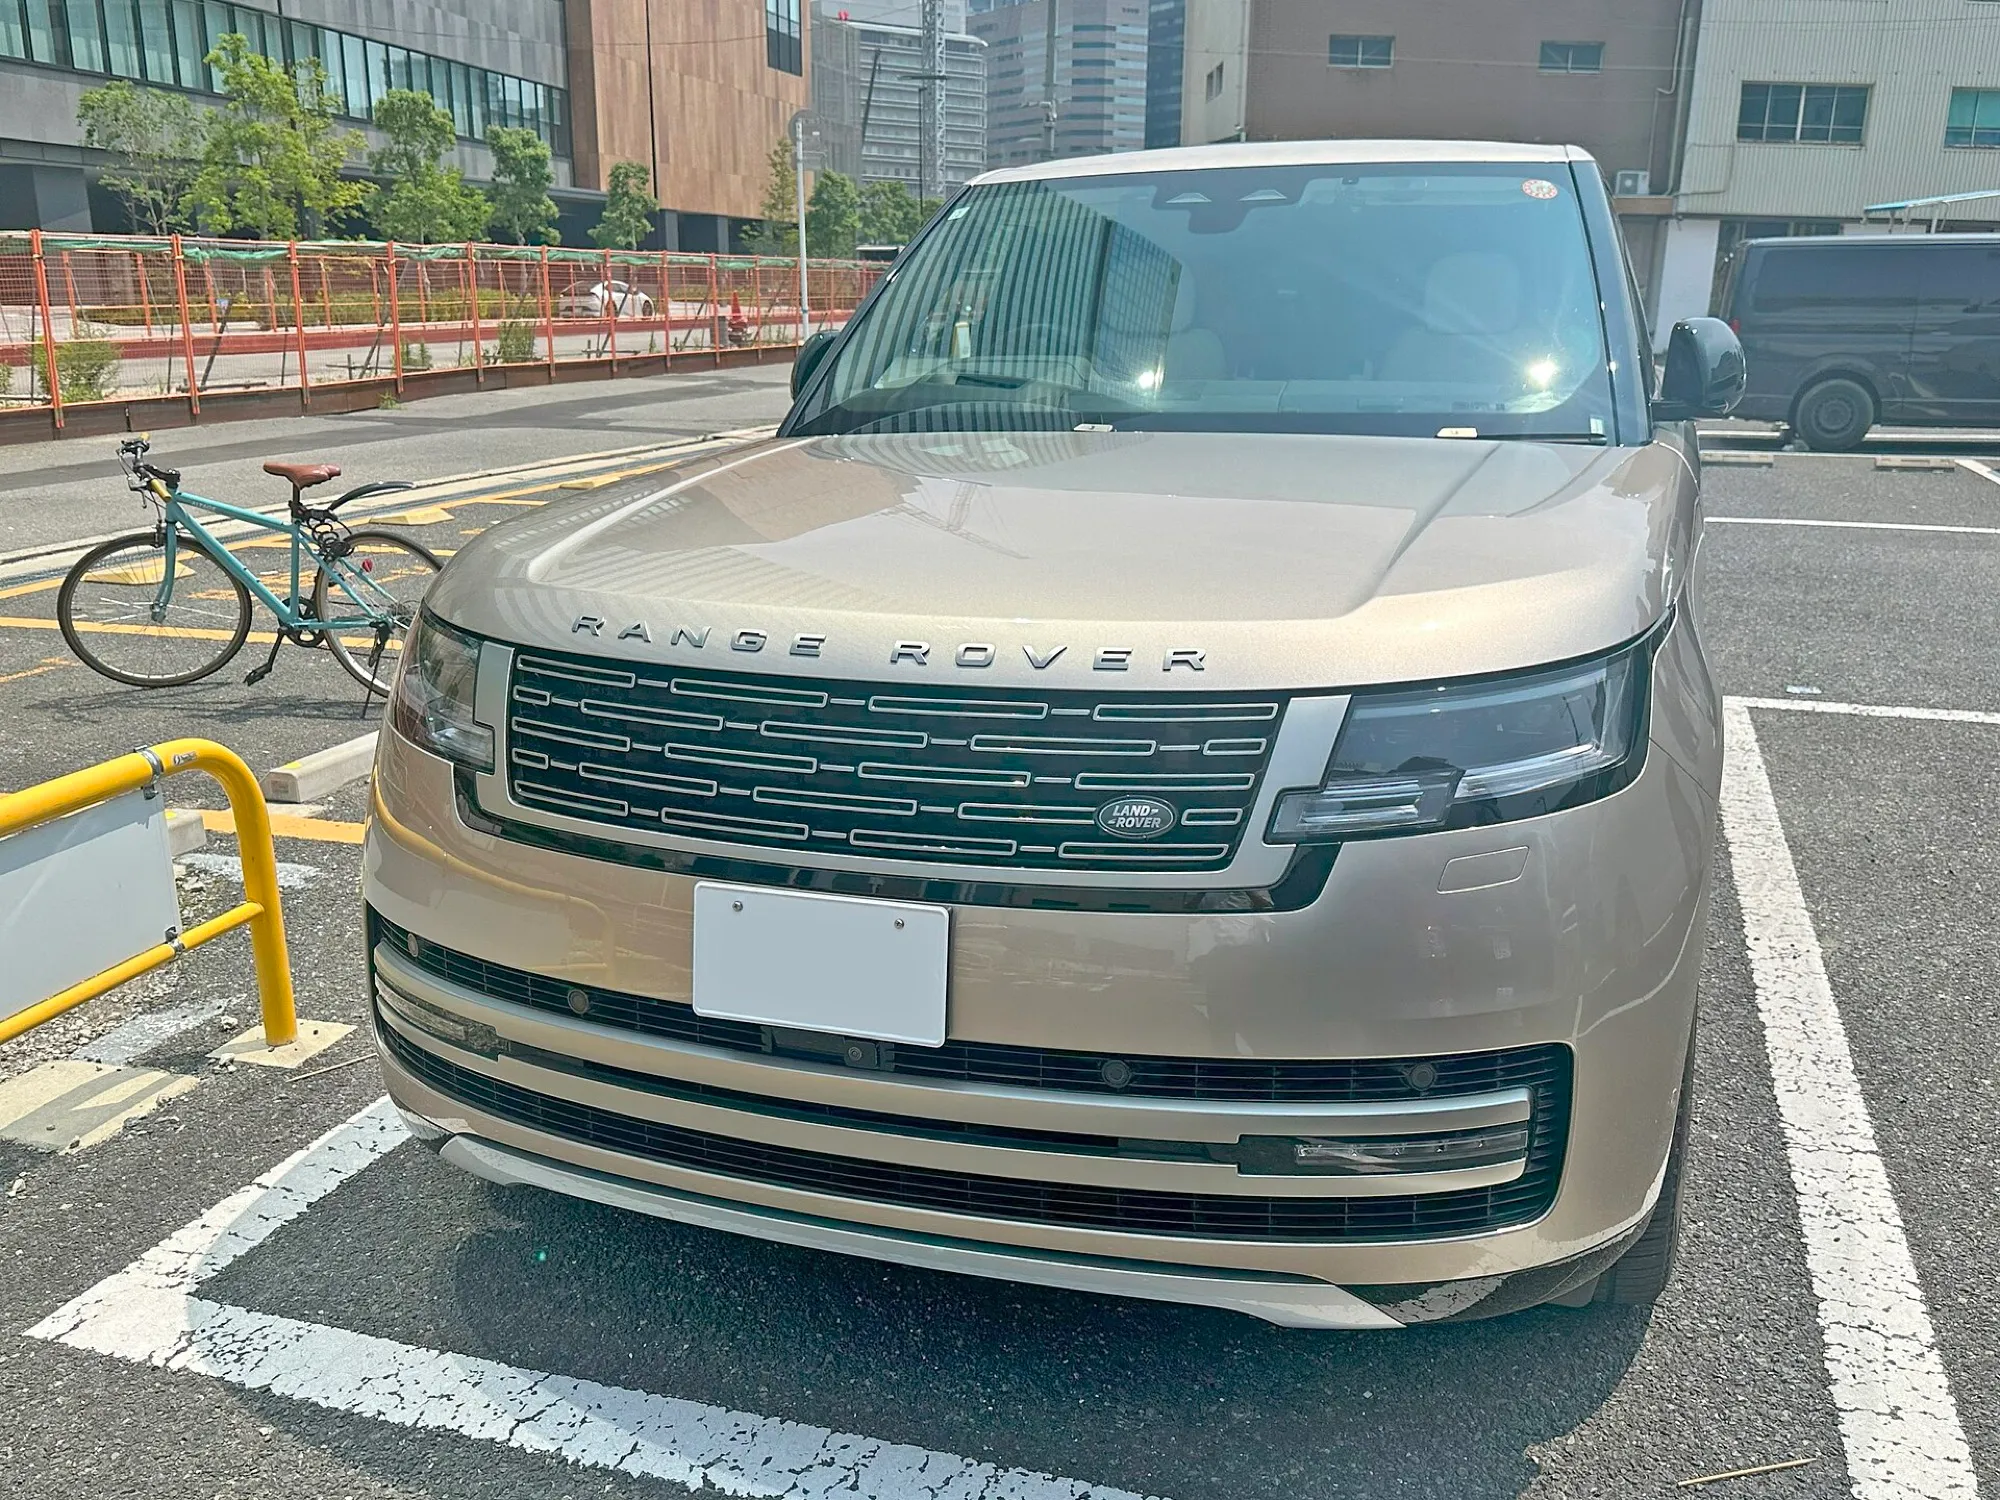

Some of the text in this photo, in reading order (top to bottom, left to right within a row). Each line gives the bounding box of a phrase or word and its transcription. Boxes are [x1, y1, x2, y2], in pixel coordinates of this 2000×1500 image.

[571, 615, 1207, 672] RANGE ROVER
[1112, 805, 1151, 816] LAND
[1115, 817, 1161, 828] ROVER
